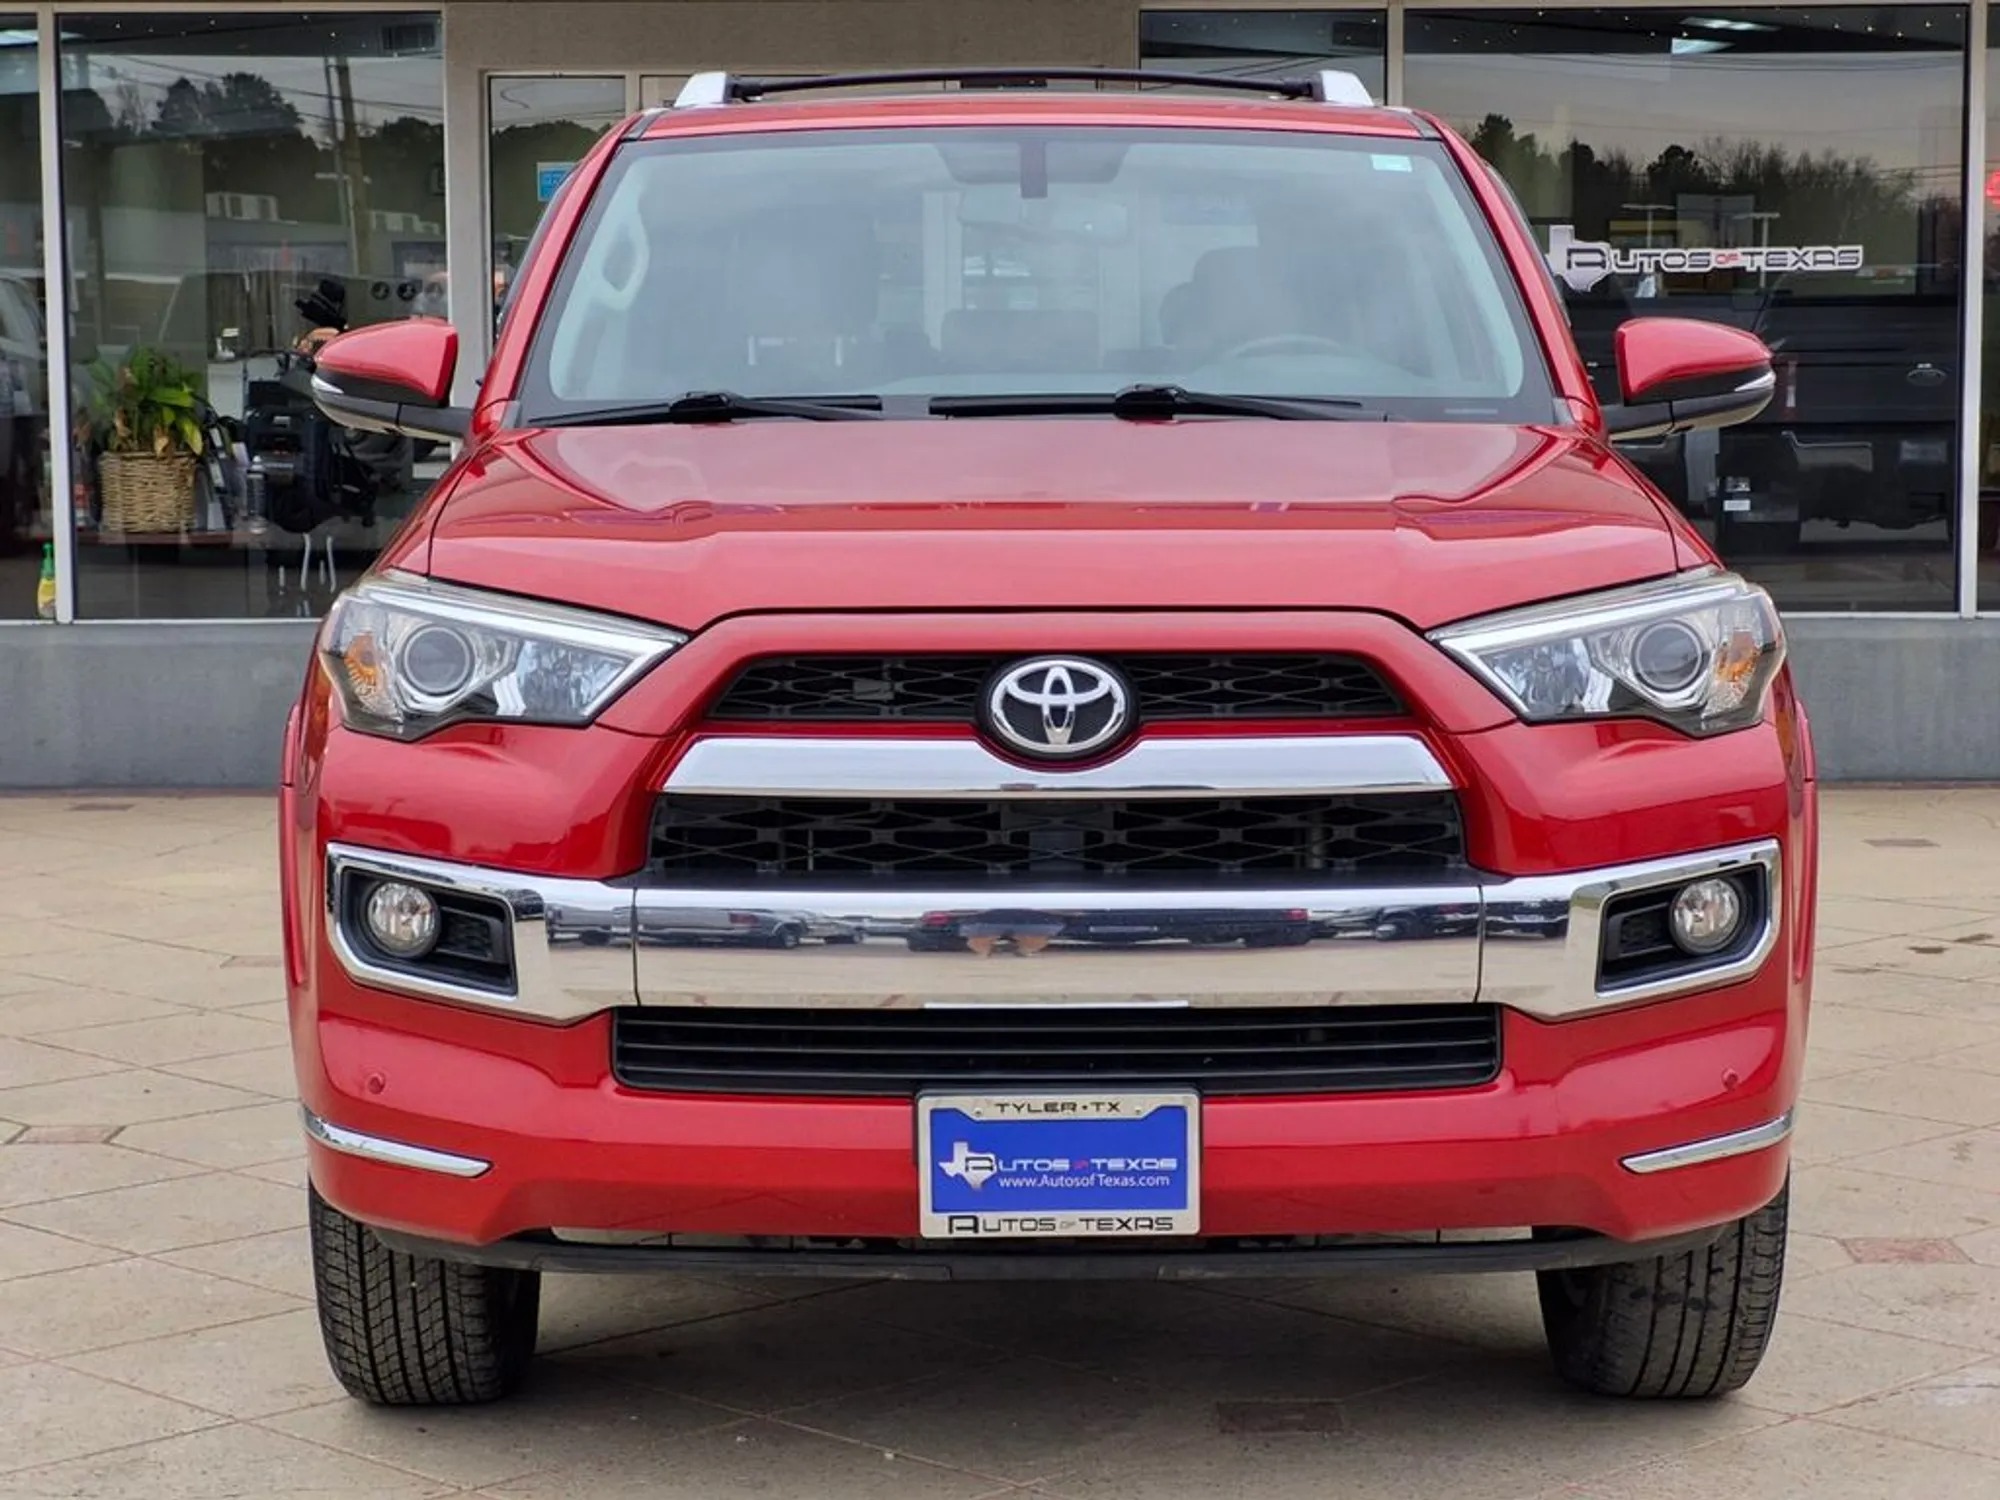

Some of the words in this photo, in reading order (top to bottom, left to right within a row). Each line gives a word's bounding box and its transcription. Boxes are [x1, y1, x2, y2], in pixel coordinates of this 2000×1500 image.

[1567, 249, 1711, 271] AUTOS
[1715, 253, 1739, 266] OF
[1746, 246, 1861, 270] TEXAS
[994, 1101, 1077, 1113] TYLER
[1090, 1101, 1121, 1113] TX
[965, 1156, 1070, 1171] AUTOS
[1090, 1157, 1178, 1171] TEXAS
[1000, 1173, 1170, 1188] www.AutosofTexas.com
[948, 1215, 1056, 1235] AUTOS
[1079, 1216, 1174, 1232] TEXAS
